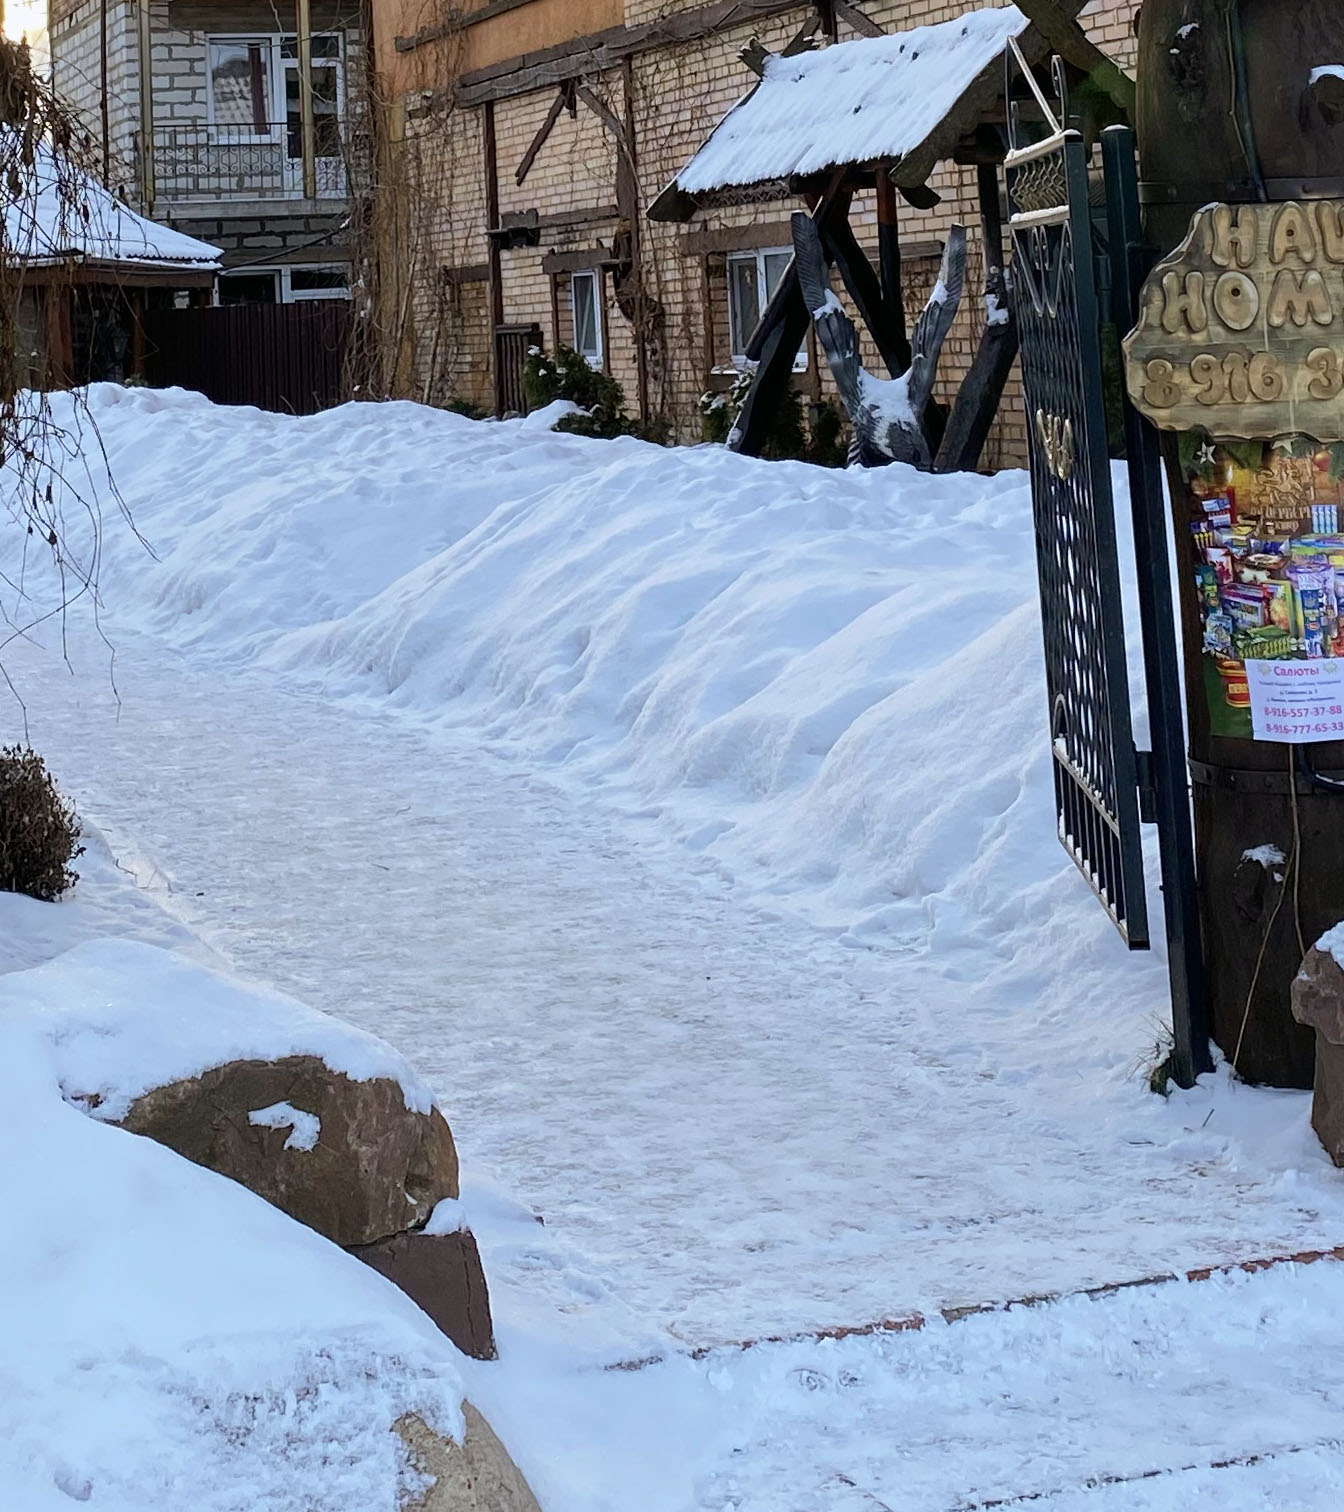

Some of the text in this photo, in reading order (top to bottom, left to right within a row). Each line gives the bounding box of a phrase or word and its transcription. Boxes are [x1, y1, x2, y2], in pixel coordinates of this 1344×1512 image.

[1143, 358, 1182, 408] 8
[1189, 347, 1285, 406] 916
[1273, 666, 1320, 677] Салюты
